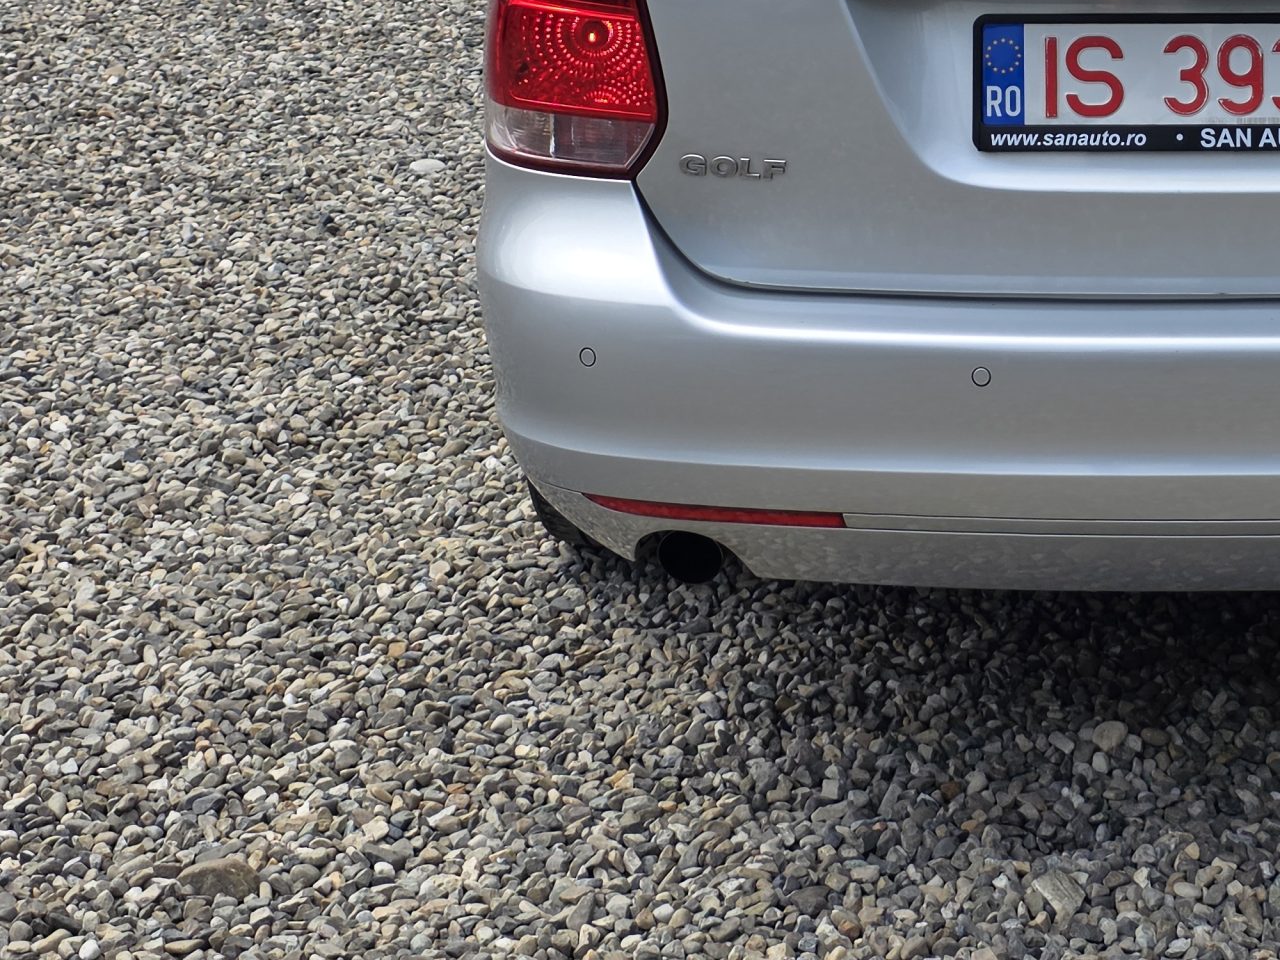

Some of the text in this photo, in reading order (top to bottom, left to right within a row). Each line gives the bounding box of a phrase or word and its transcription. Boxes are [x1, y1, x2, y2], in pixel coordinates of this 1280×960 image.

[1045, 35, 1124, 118] IS
[986, 85, 1021, 117] RO
[990, 129, 1147, 147] www.sanauto.ro
[1200, 127, 1257, 148] SAN
[679, 153, 787, 180] GOLF
